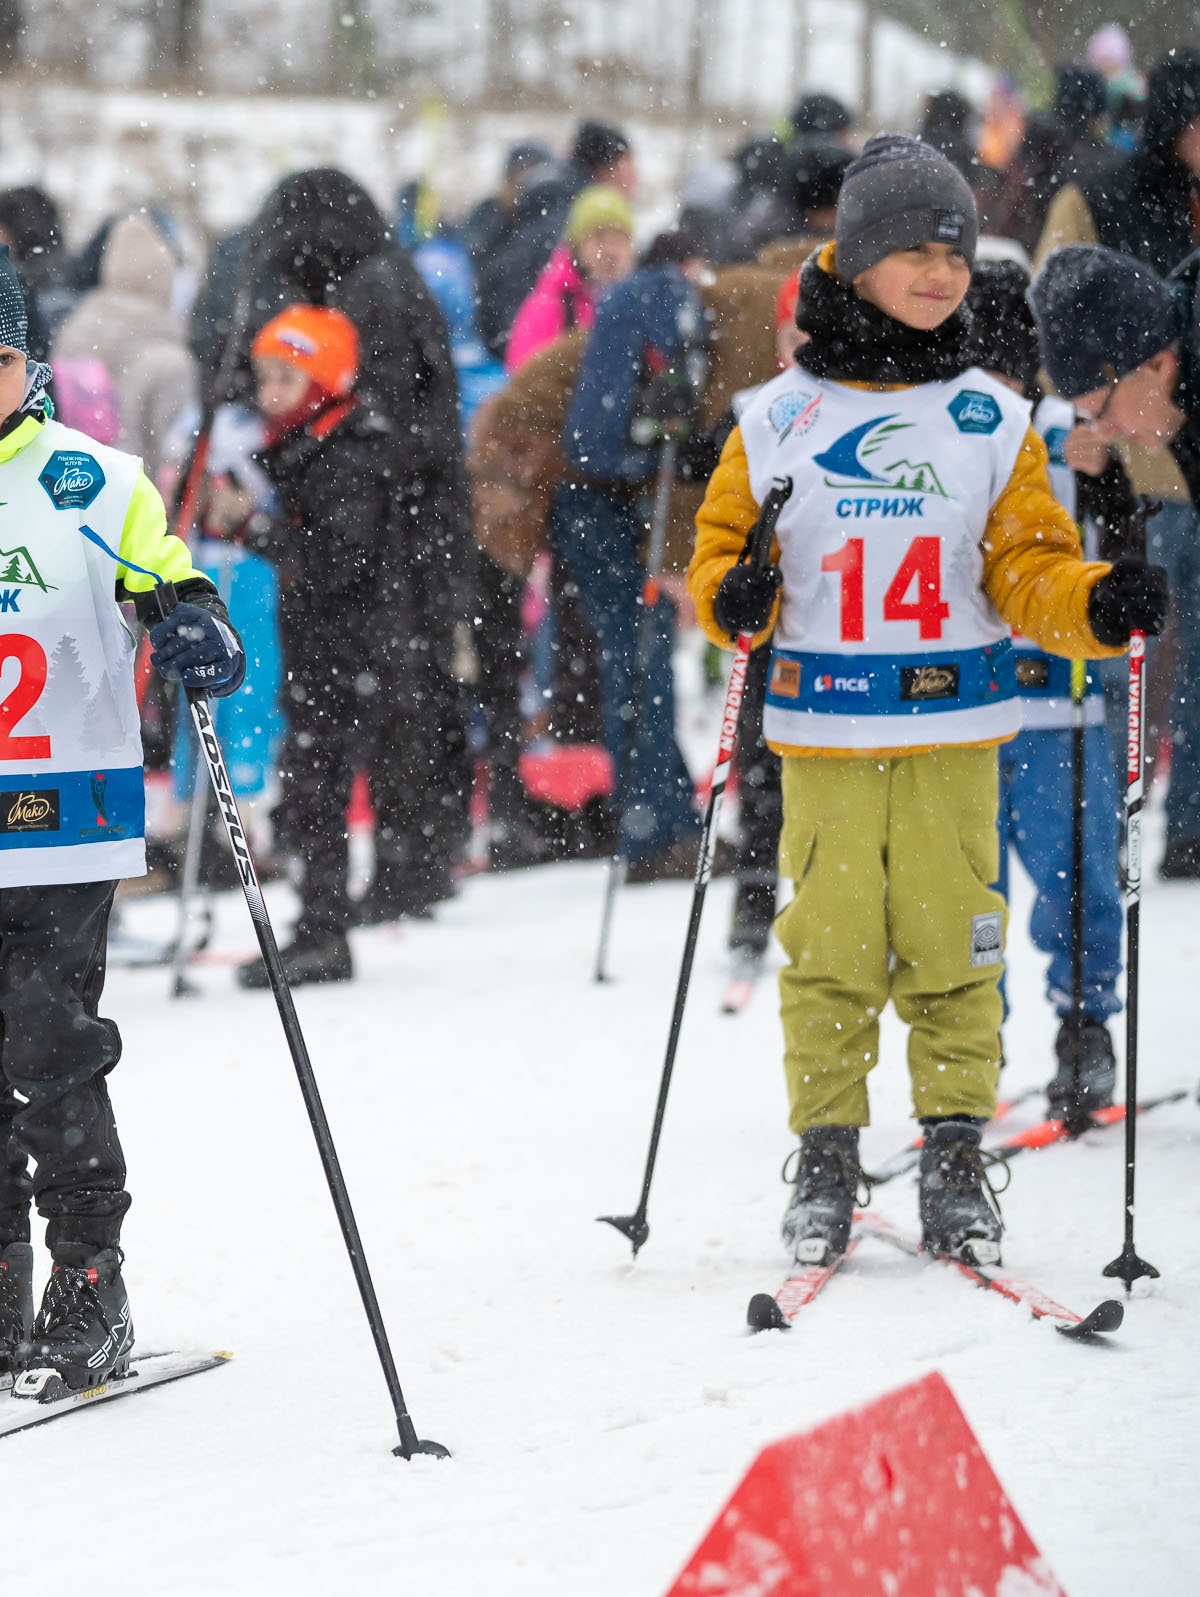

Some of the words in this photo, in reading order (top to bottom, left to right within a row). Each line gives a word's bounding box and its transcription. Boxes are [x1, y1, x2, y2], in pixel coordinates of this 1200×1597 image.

[836, 498, 925, 518] СТРИЖ
[820, 535, 950, 643] 14
[719, 651, 749, 751] NORDWAY
[834, 676, 870, 692] ПСБ
[1127, 673, 1141, 773] NORDWAY
[195, 700, 257, 887] ADSHUS
